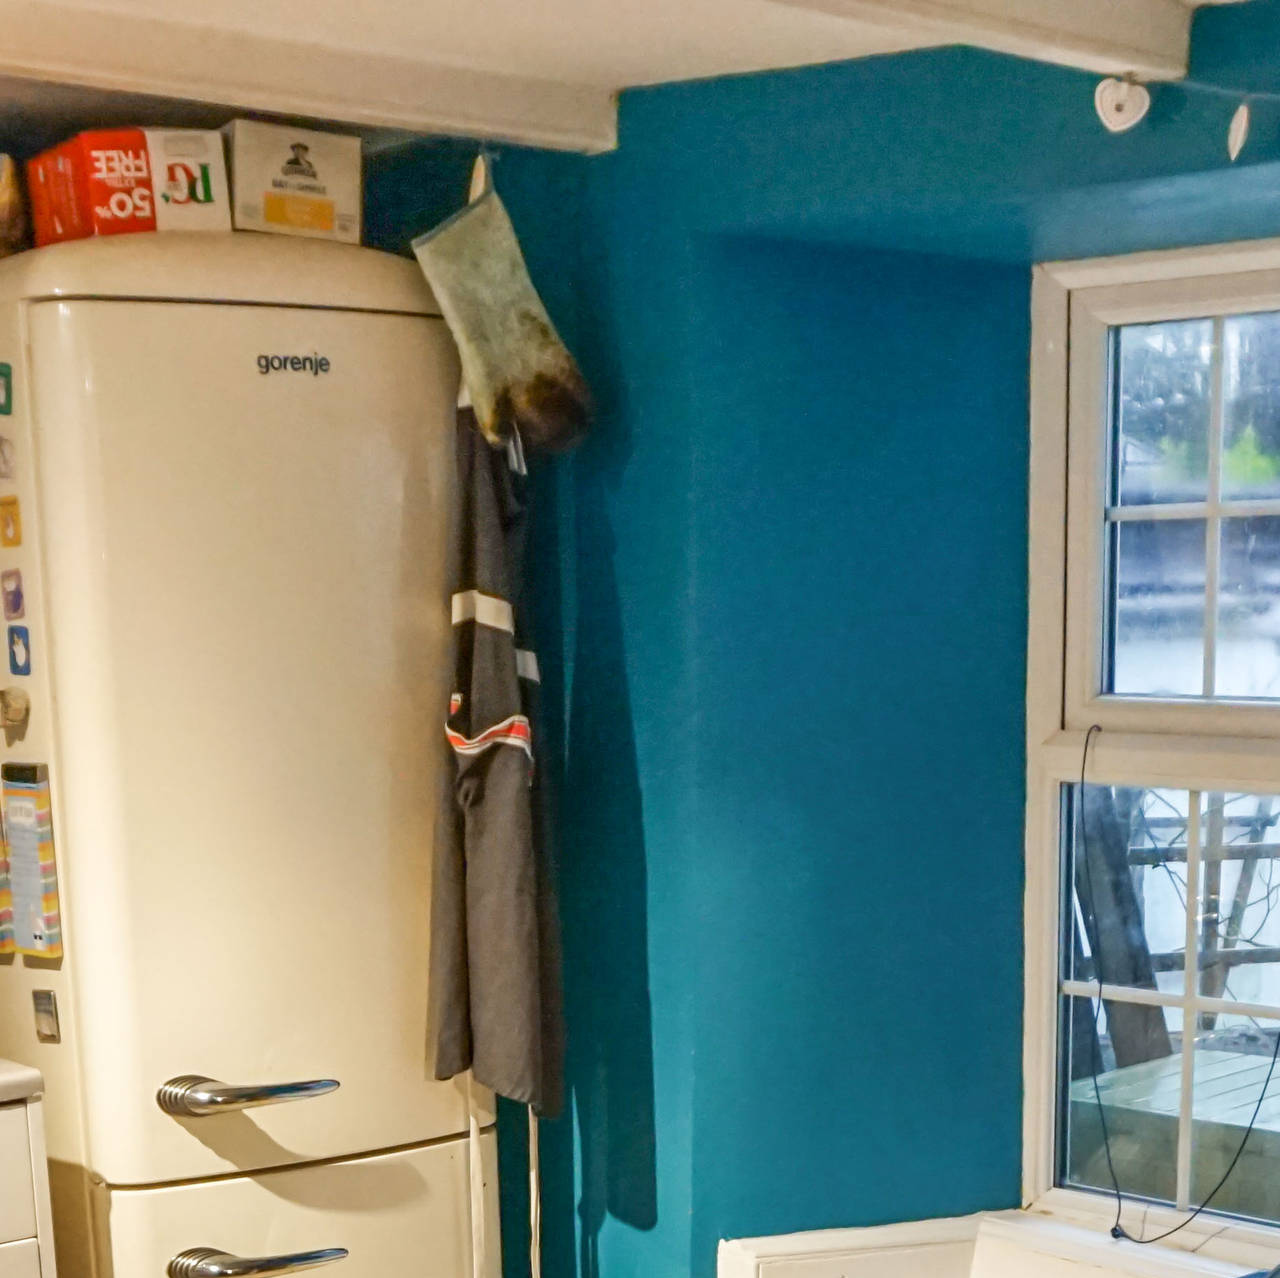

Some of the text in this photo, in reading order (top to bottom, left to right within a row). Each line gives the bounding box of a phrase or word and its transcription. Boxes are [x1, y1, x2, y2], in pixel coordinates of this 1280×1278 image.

[90, 149, 148, 178] FREE
[167, 162, 215, 204] PG
[94, 187, 152, 218] 50%
[257, 352, 330, 376] gorenje
